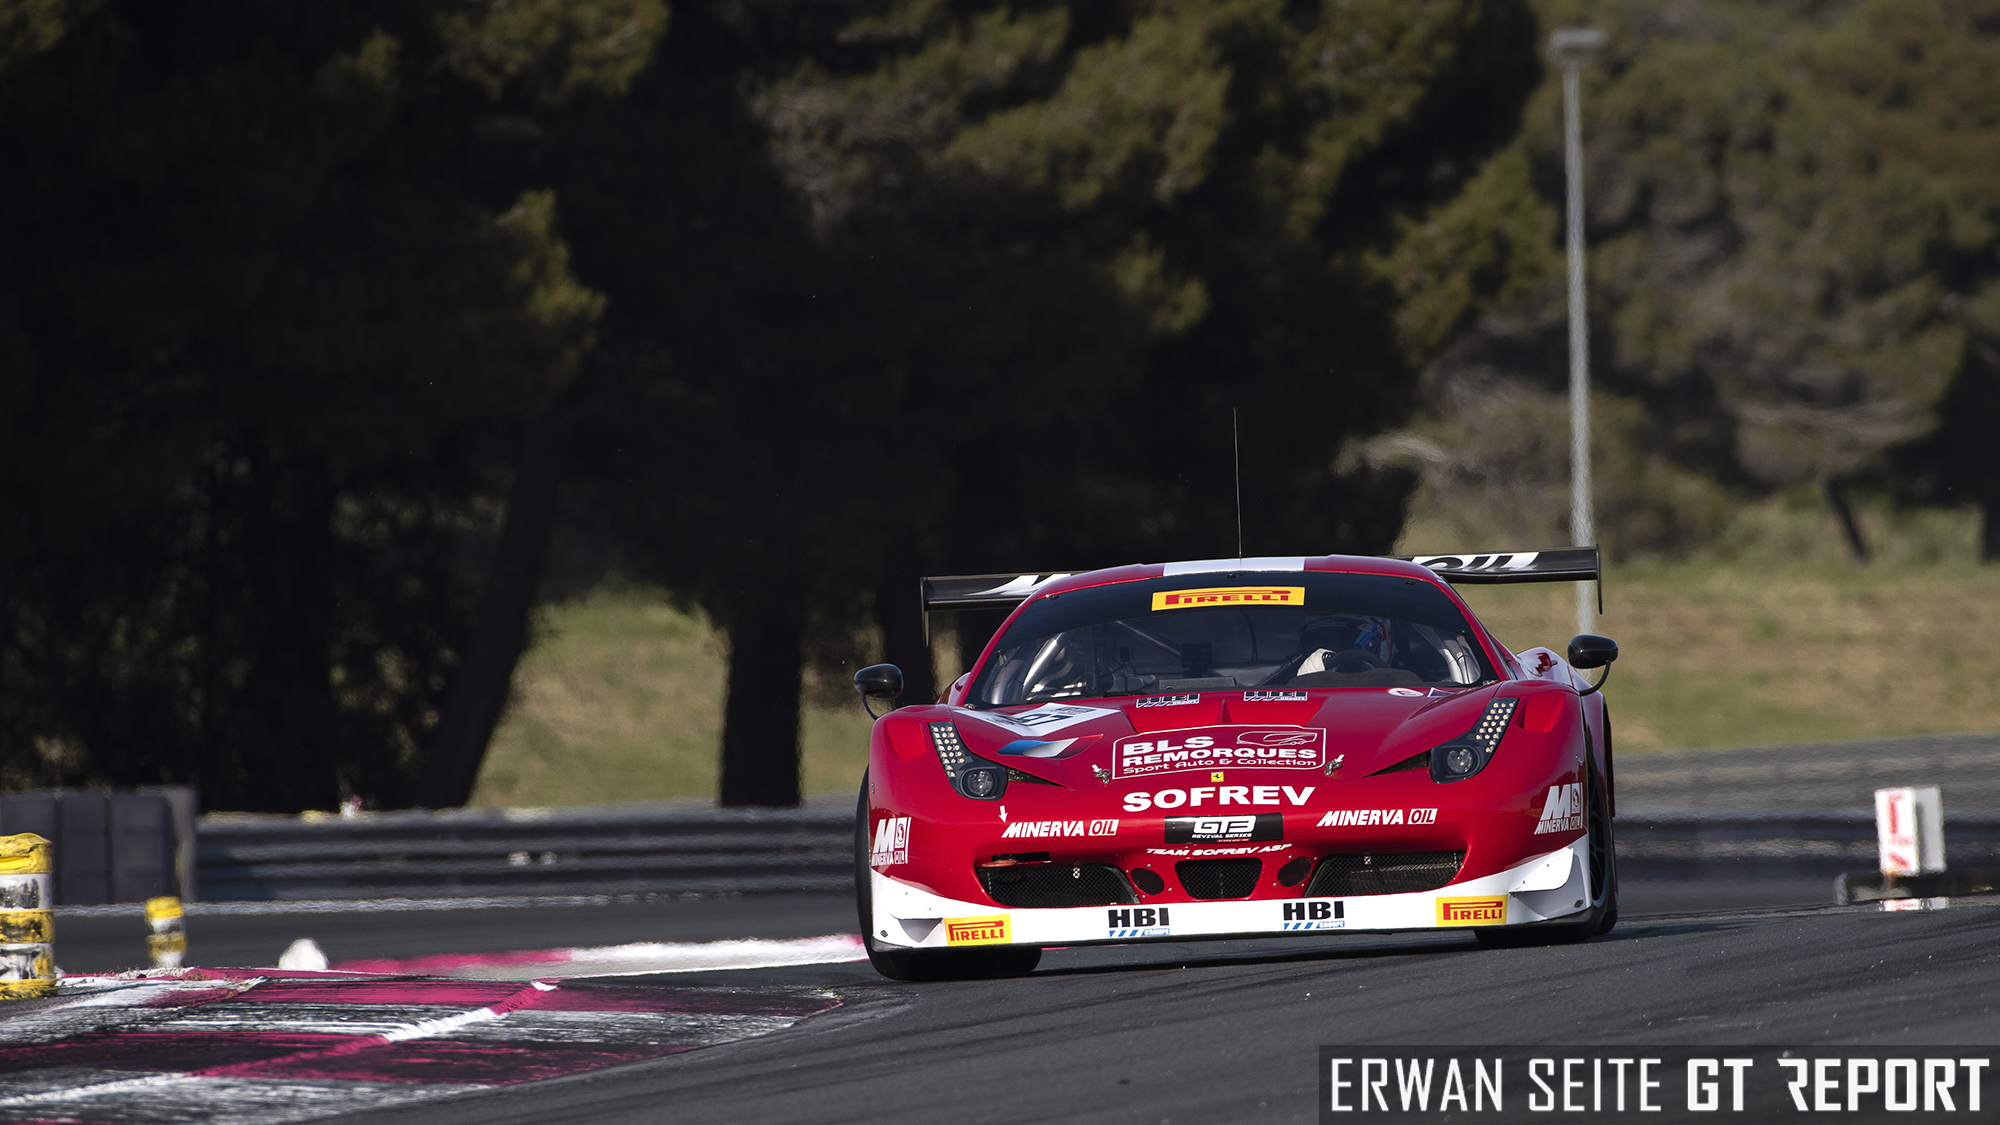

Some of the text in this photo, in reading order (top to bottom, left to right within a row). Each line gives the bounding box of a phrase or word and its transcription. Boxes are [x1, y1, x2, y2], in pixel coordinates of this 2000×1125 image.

[1165, 590, 1291, 605] PIRELLI
[1122, 736, 1215, 756] BLS
[1122, 748, 1318, 767] REMORQUES
[1123, 762, 1170, 775] Sport
[1174, 758, 1215, 769] Auto
[1236, 758, 1317, 767] Collection
[1122, 785, 1316, 813] SOFREV
[1192, 815, 1257, 834] GT3
[1316, 809, 1434, 827] MINERVA OIL
[1001, 820, 1116, 838] MINERVA OIL
[1146, 843, 1293, 856] TEAM SOFREV ASP
[1107, 907, 1170, 929] HBI
[1283, 900, 1345, 921] HBI
[1442, 900, 1504, 921] PIRELLI
[947, 920, 1005, 942] PIRELLI
